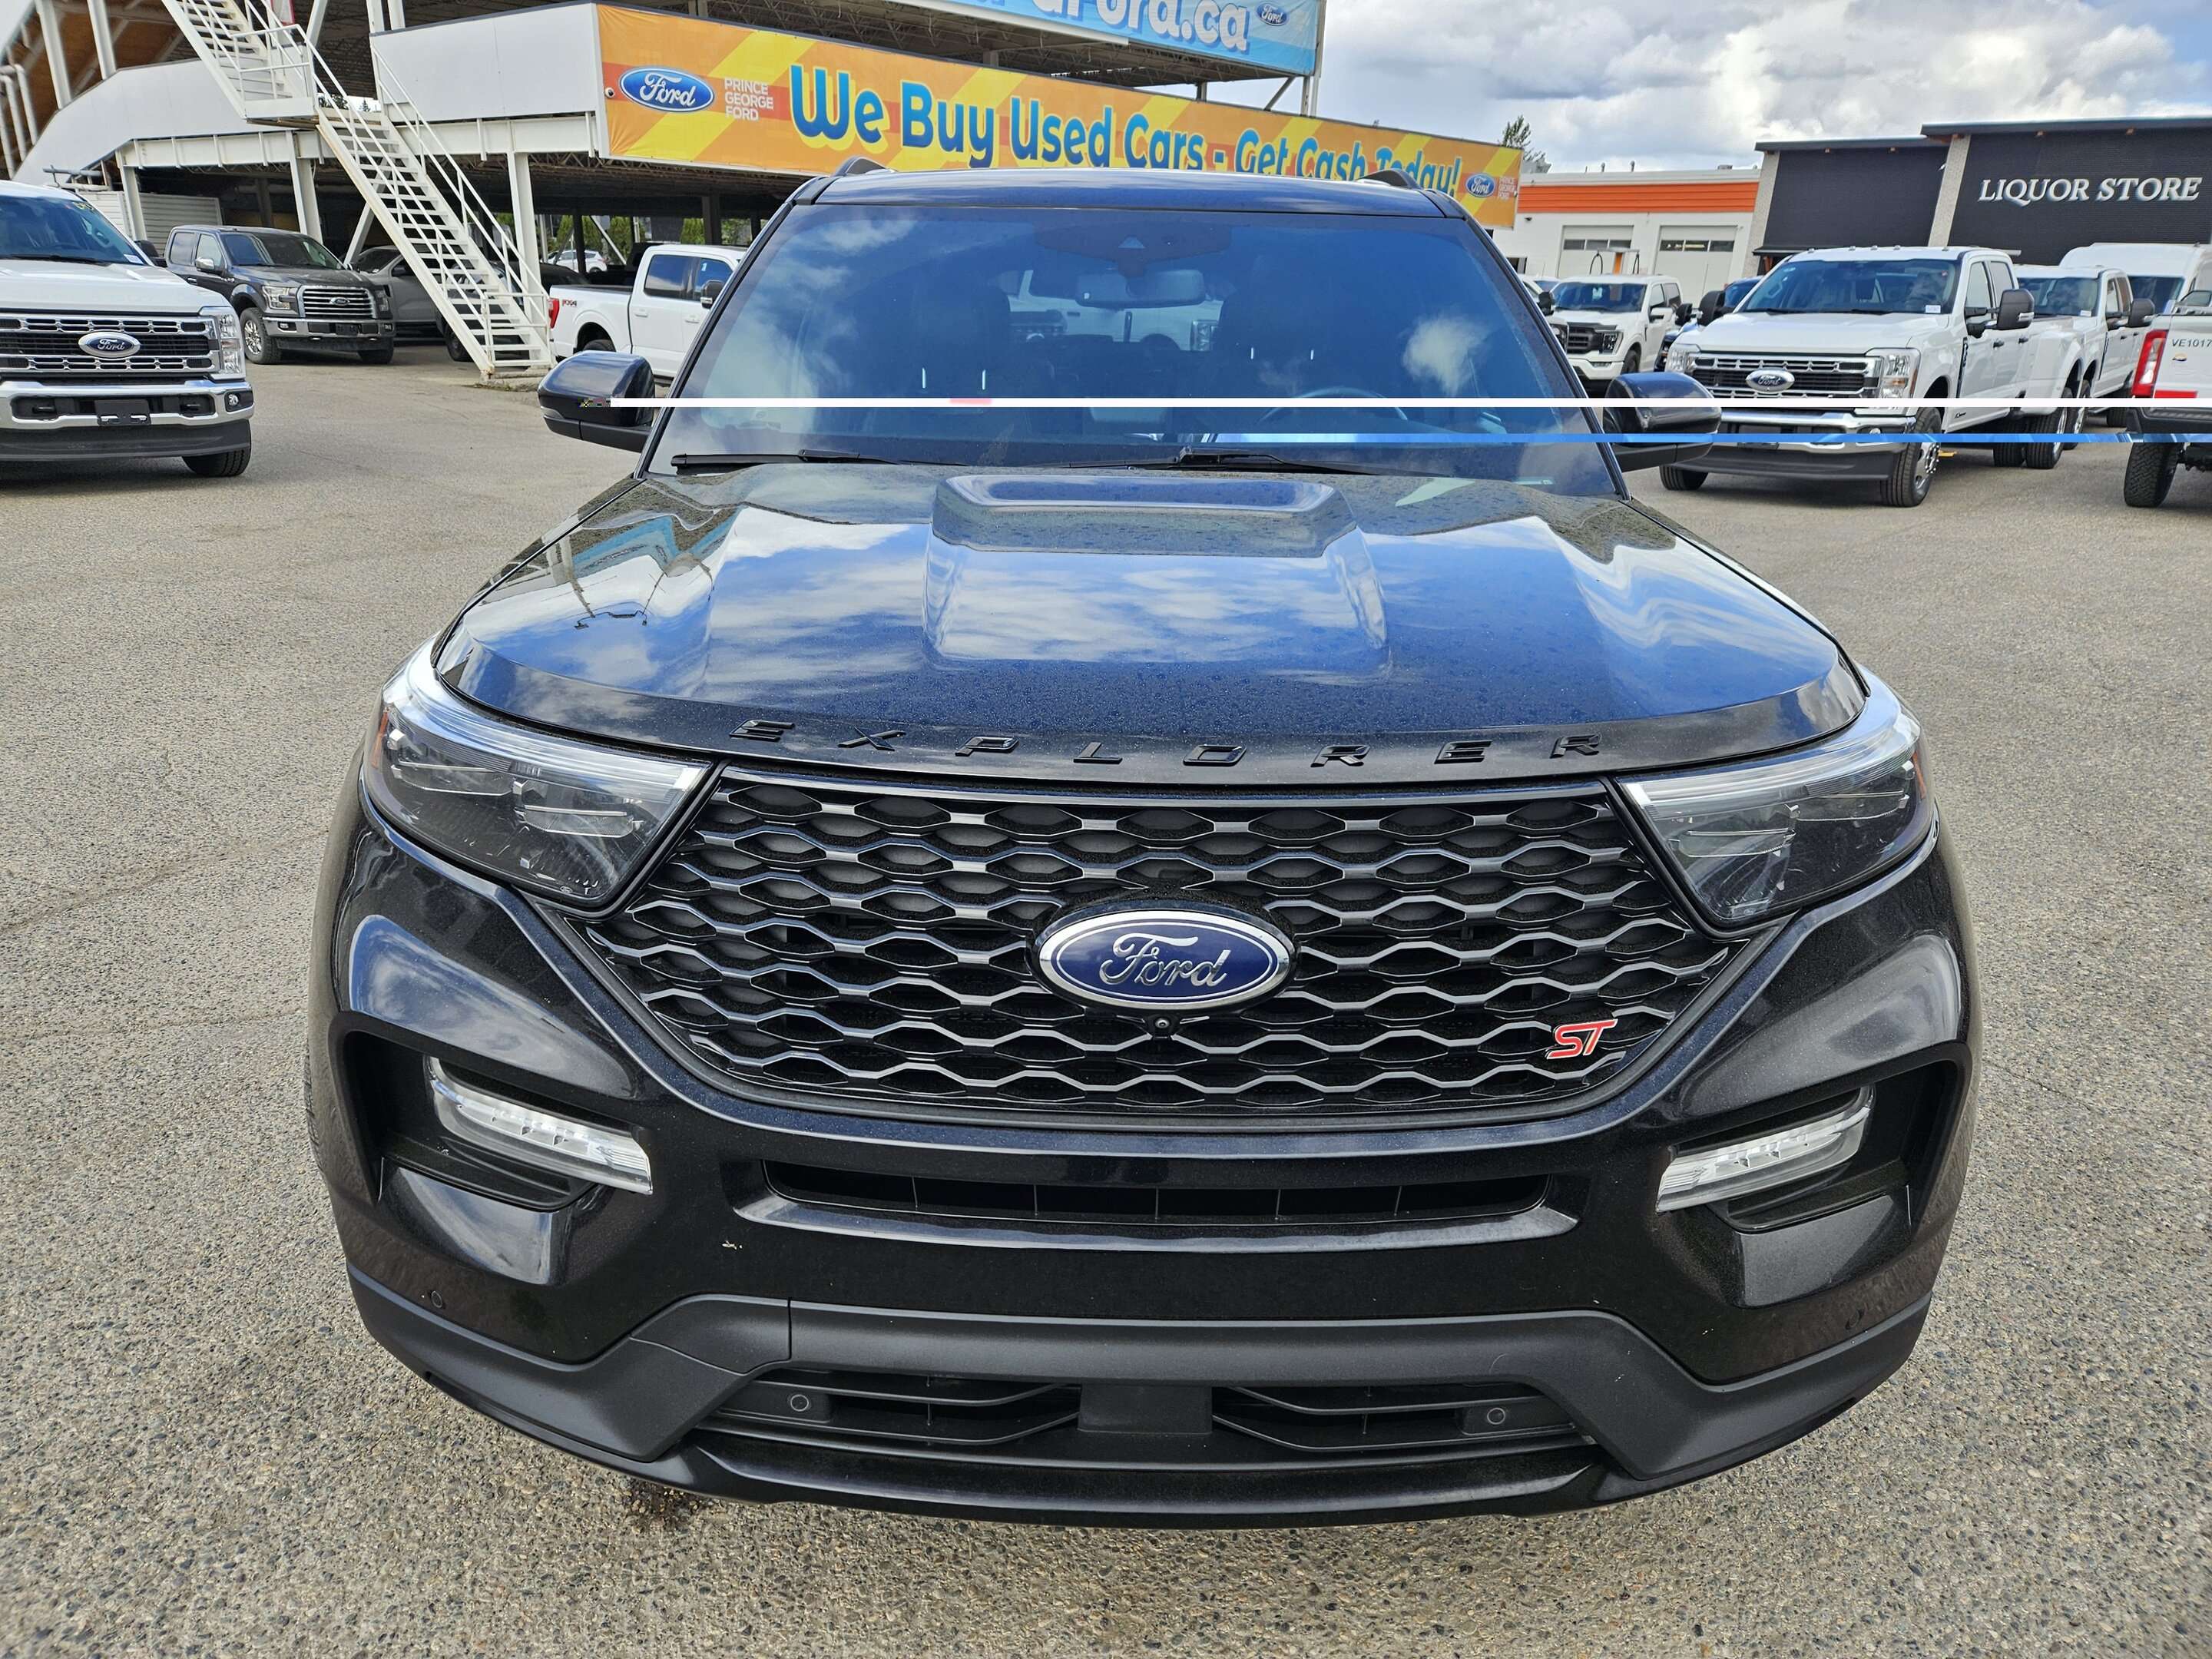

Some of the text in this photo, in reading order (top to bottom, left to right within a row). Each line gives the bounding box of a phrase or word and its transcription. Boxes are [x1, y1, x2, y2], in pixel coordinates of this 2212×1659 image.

[1261, 4, 1283, 24] Ford
[639, 72, 696, 107] Ford
[724, 78, 768, 94] PRINCE
[724, 91, 773, 109] GEORGE
[725, 105, 760, 121] FORD
[790, 64, 884, 144] We
[901, 80, 995, 168] Buy
[1010, 97, 1112, 167] Used
[1124, 113, 1204, 170] Cars
[1235, 129, 1289, 176] Get
[1296, 137, 1366, 181] Cash
[1471, 176, 1491, 194] Ford
[1978, 177, 2203, 207] LIQUOR STORE
[98, 339, 125, 352] Ford
[1757, 375, 1781, 386] Ford
[730, 719, 1602, 767] EXPLORER
[1099, 932, 1230, 986] Ford
[1545, 1018, 1618, 1059] ST
